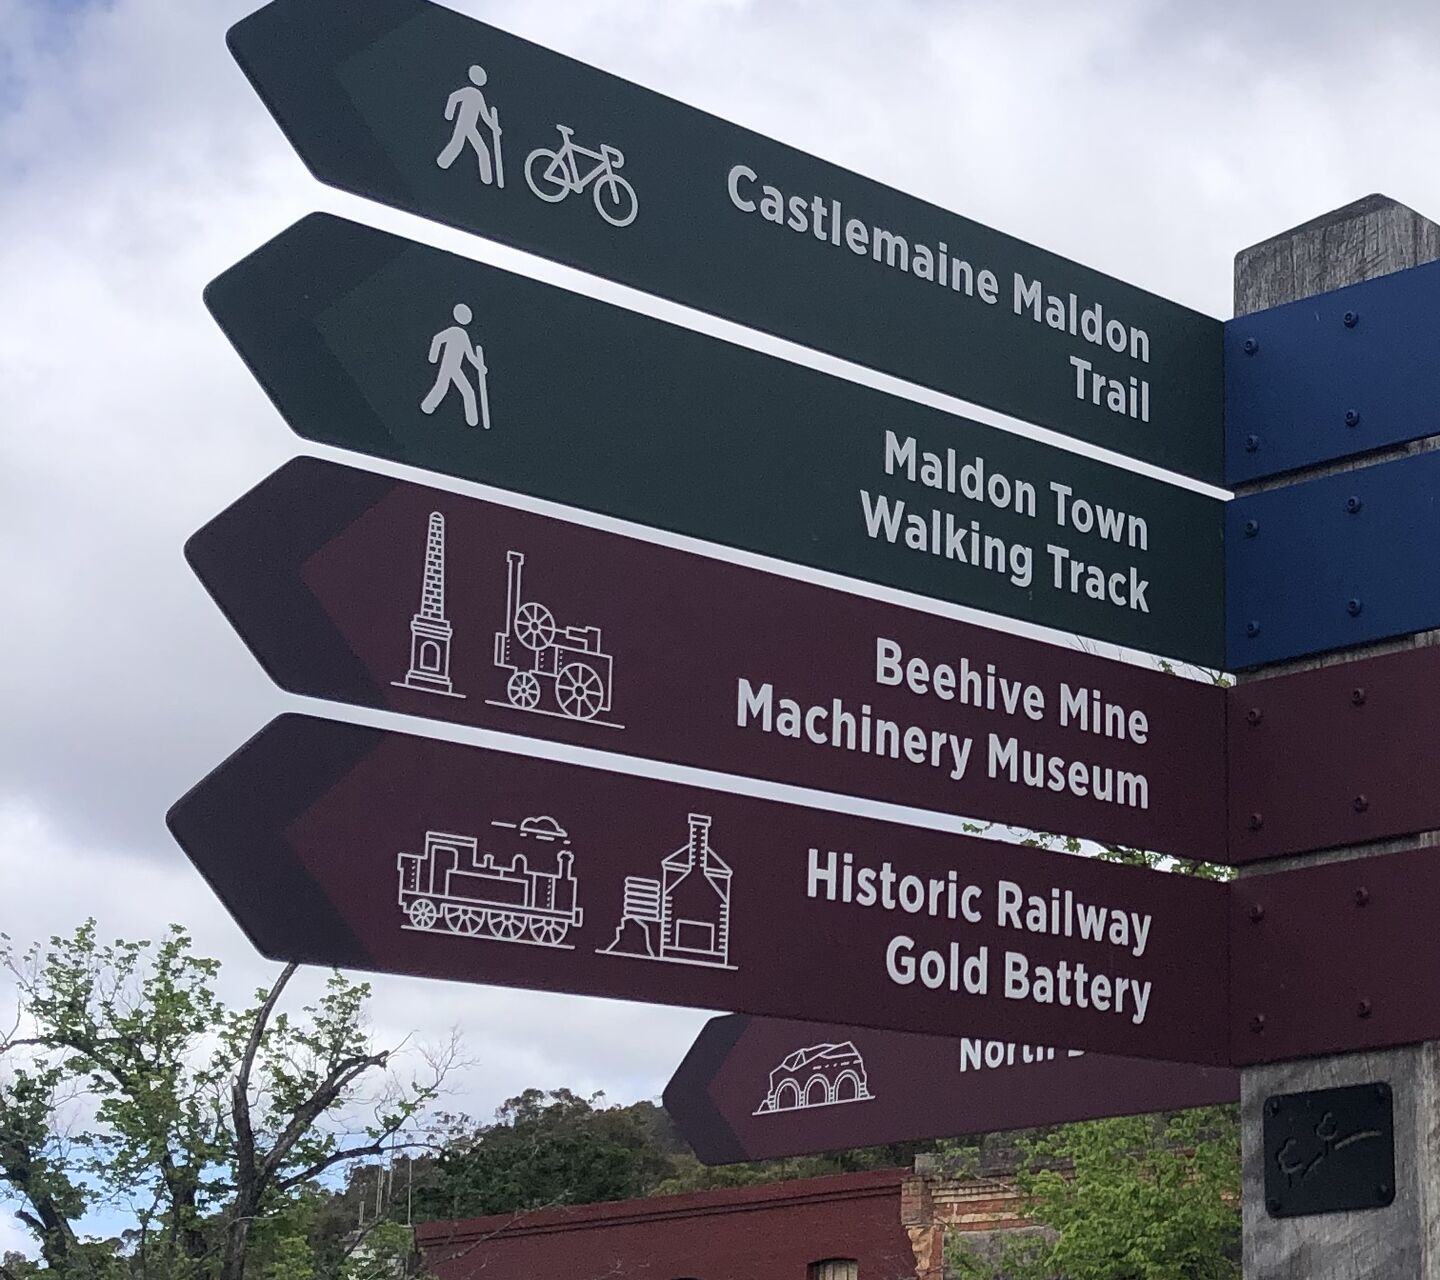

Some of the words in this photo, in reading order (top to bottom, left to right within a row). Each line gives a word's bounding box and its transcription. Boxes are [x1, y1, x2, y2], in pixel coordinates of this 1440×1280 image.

[727, 164, 999, 305] Castlemaine
[1013, 272, 1149, 363] Maldon
[1069, 355, 1149, 423] Trail
[885, 430, 1036, 518] Maldon
[1049, 481, 1148, 551] Town
[859, 489, 1033, 588] Walking
[1046, 543, 1150, 613] Track
[737, 678, 973, 781] Machinery
[988, 733, 1149, 809] Museum
[876, 637, 1045, 721] Beehive
[1060, 682, 1149, 744] Mine
[807, 848, 983, 923] Historic
[997, 879, 1152, 957] Railway
[886, 935, 988, 995] Gold
[1004, 951, 1152, 1025] Battery
